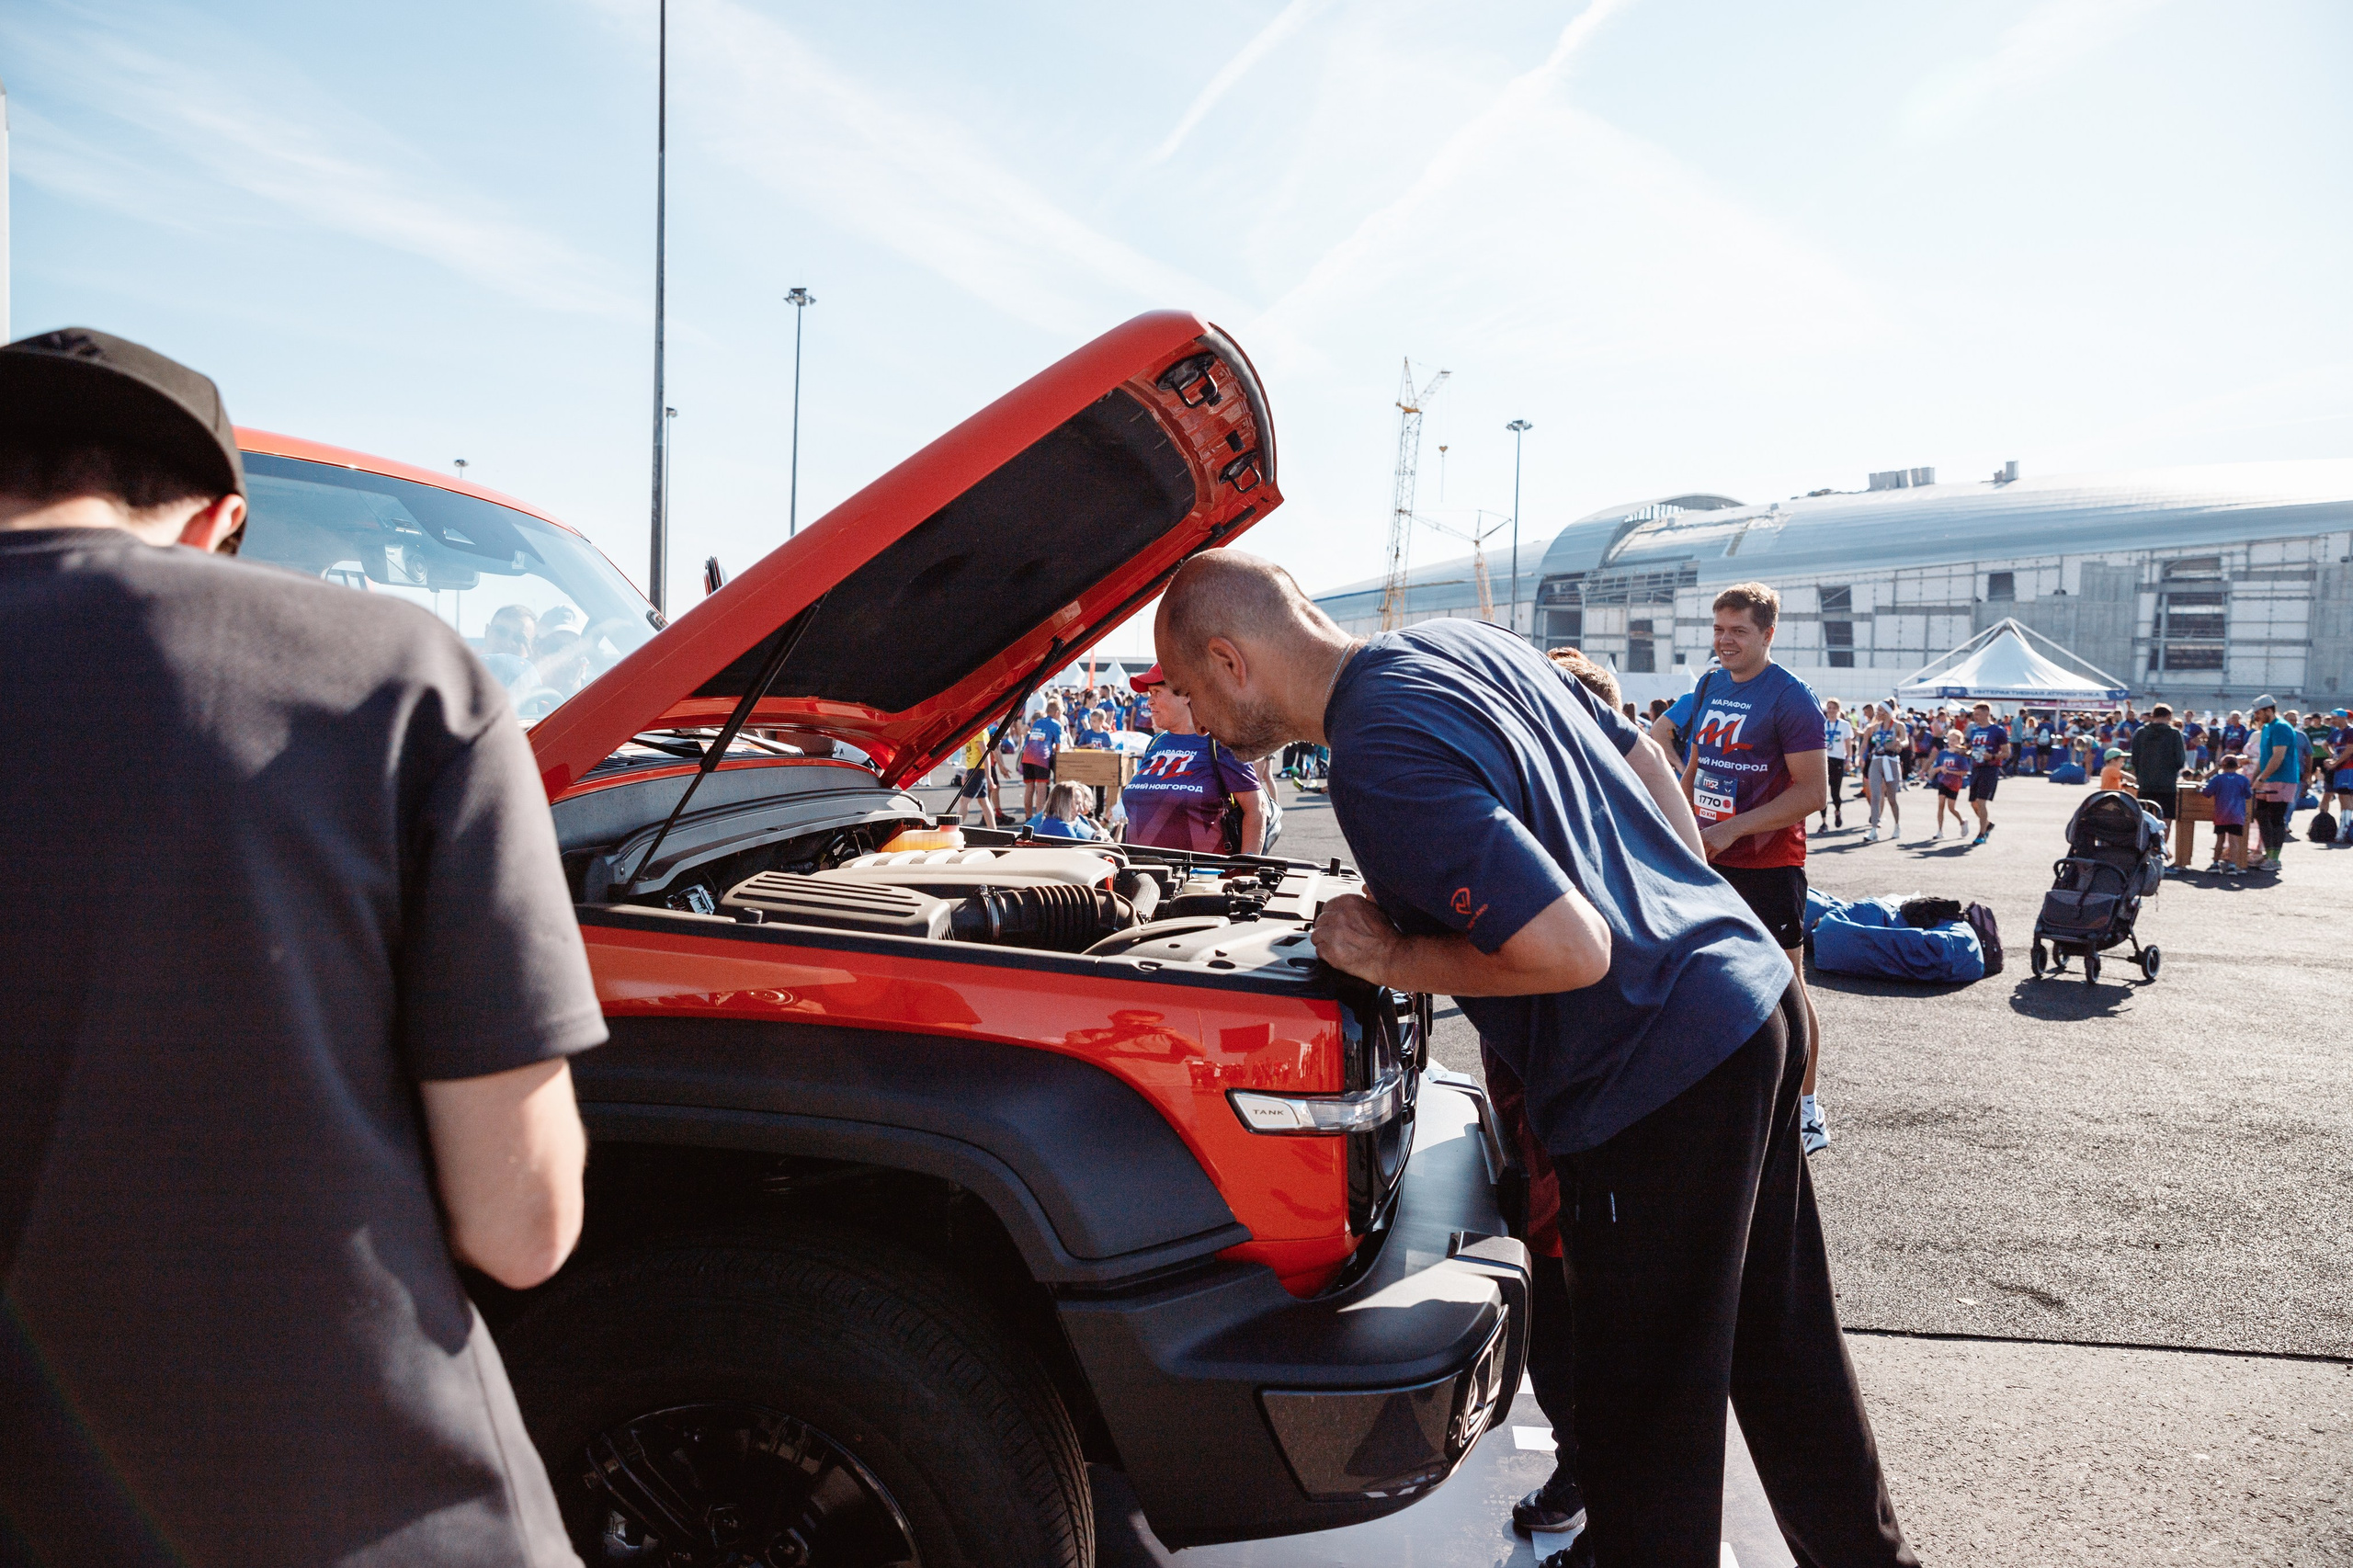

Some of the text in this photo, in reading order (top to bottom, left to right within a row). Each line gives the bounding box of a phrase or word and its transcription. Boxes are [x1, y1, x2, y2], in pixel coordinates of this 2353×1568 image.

[1711, 699, 1752, 710] МАРАФОН
[1711, 758, 1768, 772] НОВГОРОД
[1148, 783, 1203, 793] НОВГОРОД
[1699, 794, 1722, 808] 1770
